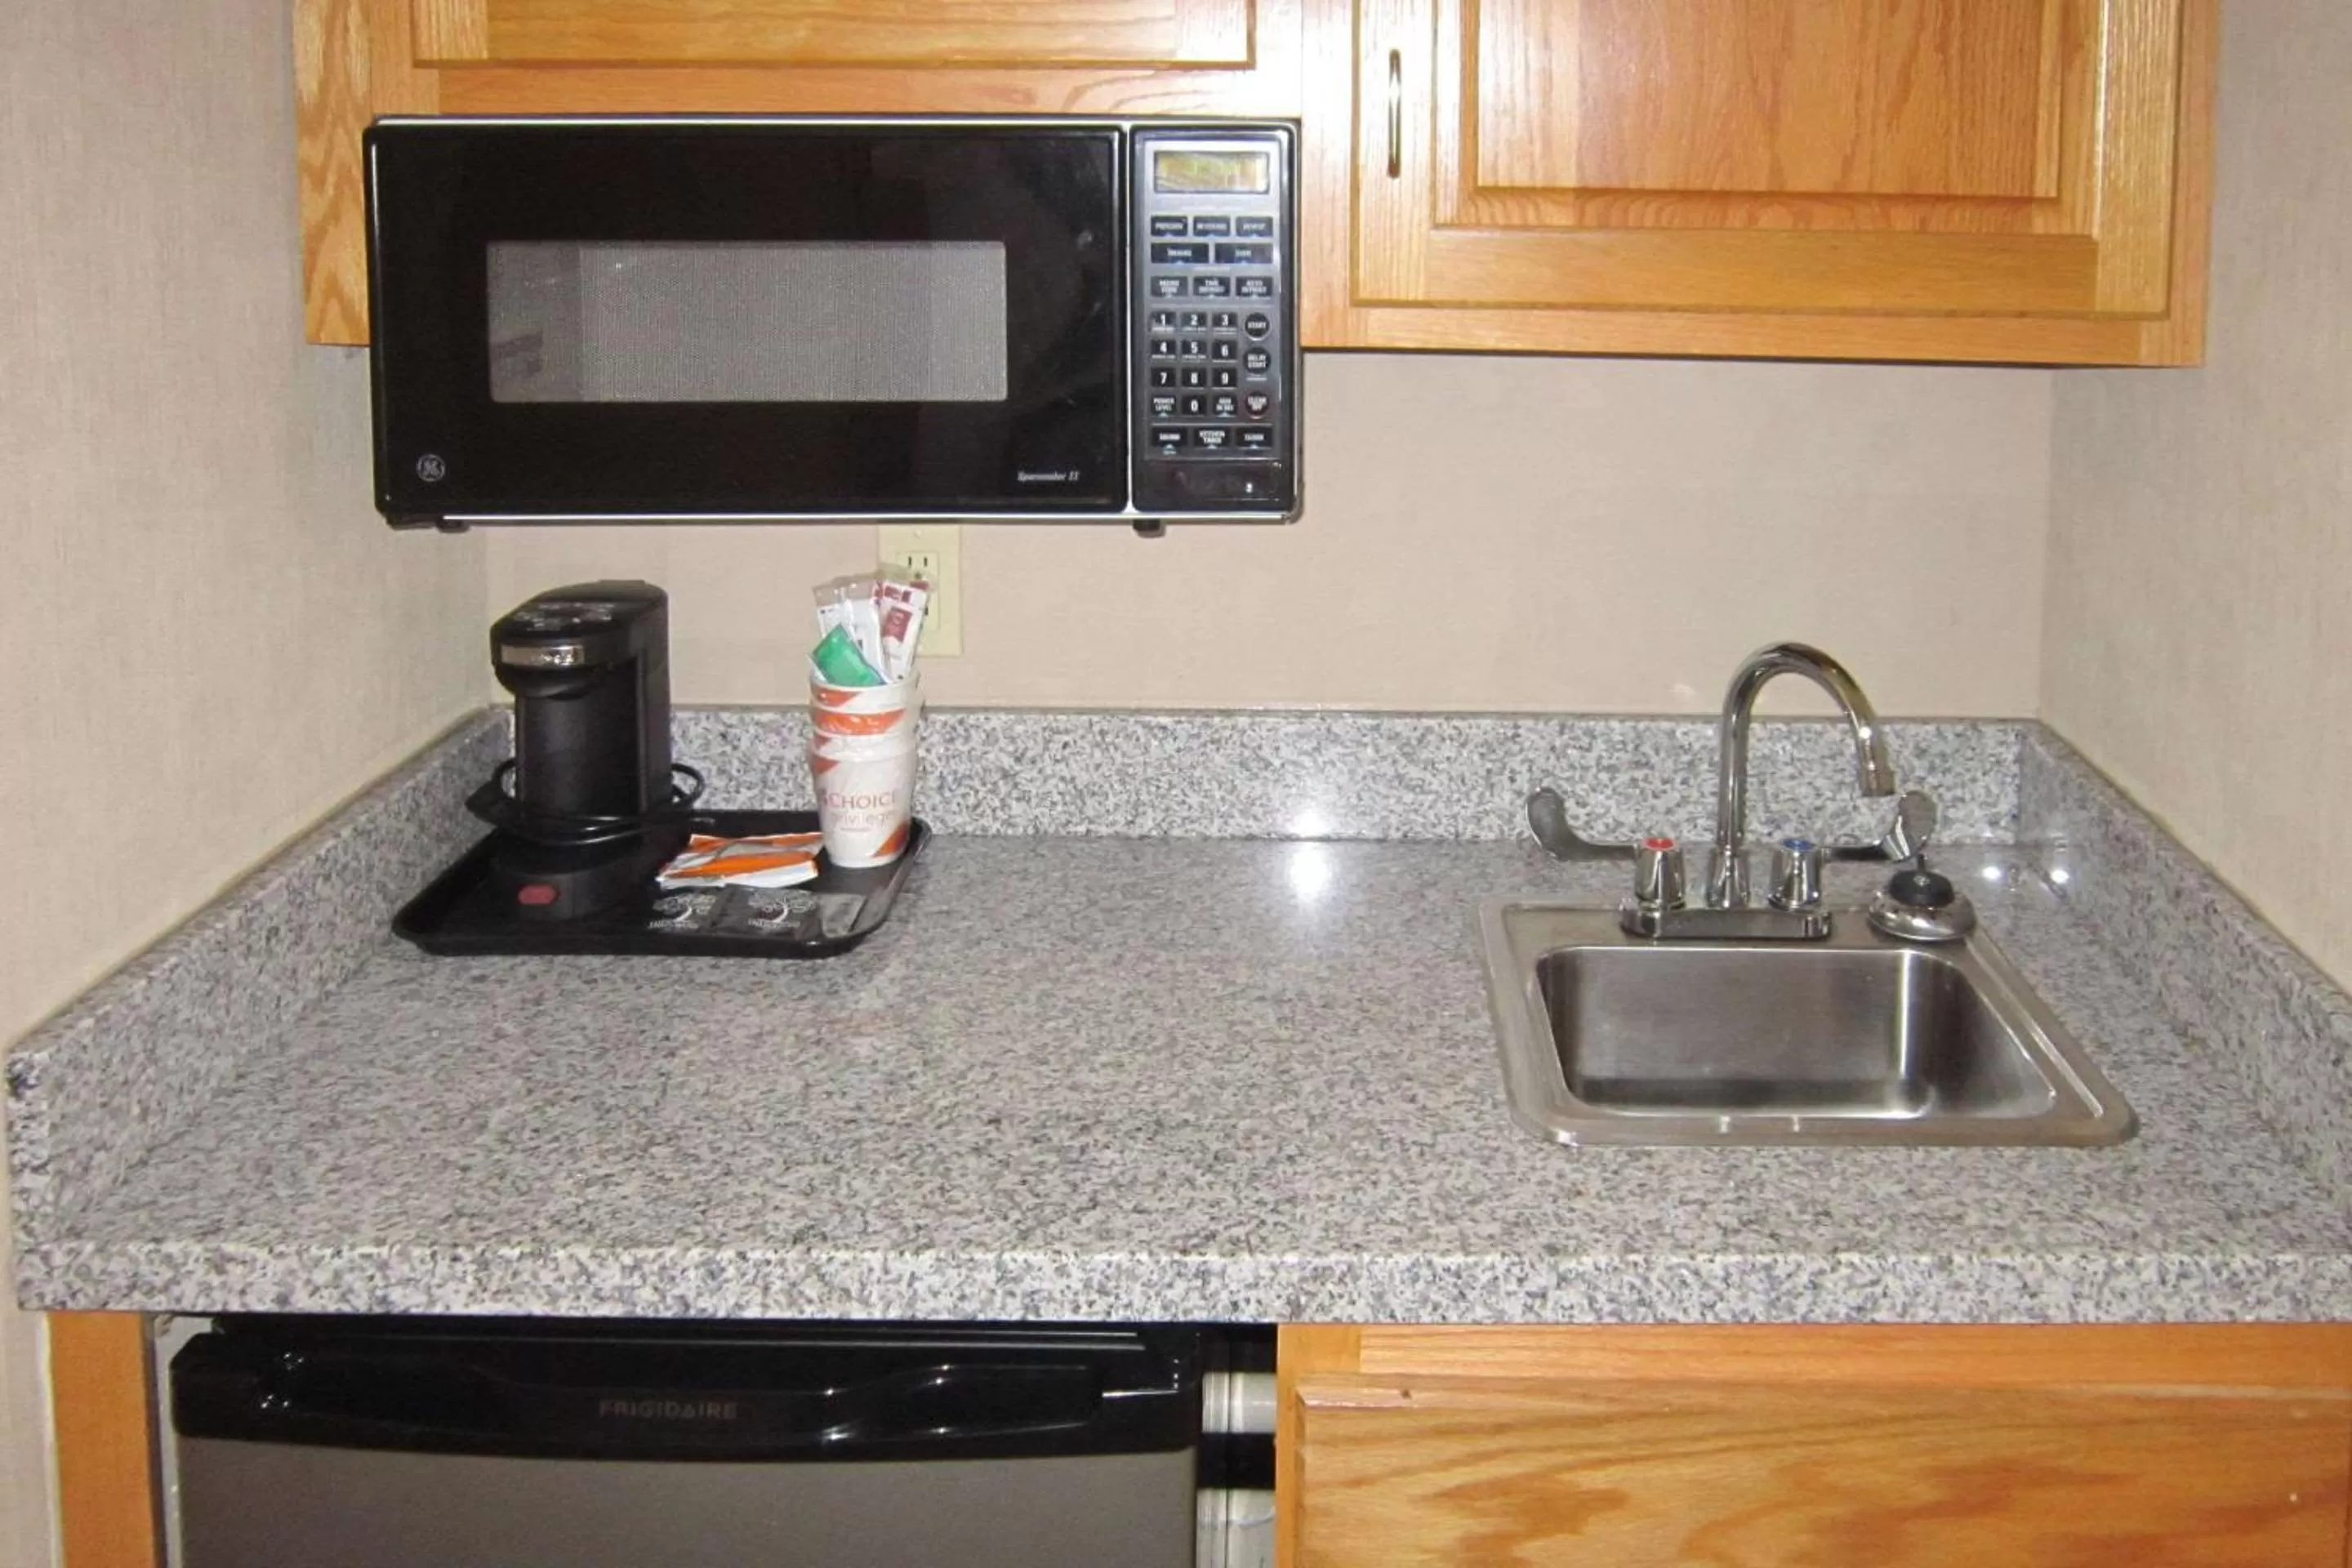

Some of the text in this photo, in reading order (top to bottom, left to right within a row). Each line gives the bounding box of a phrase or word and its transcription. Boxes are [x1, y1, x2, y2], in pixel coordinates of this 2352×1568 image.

[1160, 314, 1166, 326] 1
[1191, 314, 1198, 325] 2
[1222, 314, 1229, 326] 3
[1160, 341, 1168, 353] 4
[1191, 341, 1198, 353] 5
[1221, 344, 1228, 357] 6
[1160, 372, 1167, 385] 7
[1191, 372, 1198, 385] 8
[1222, 372, 1228, 385] 9
[1191, 399, 1198, 412] 0
[599, 1401, 738, 1419] FRIGIDAIRE
